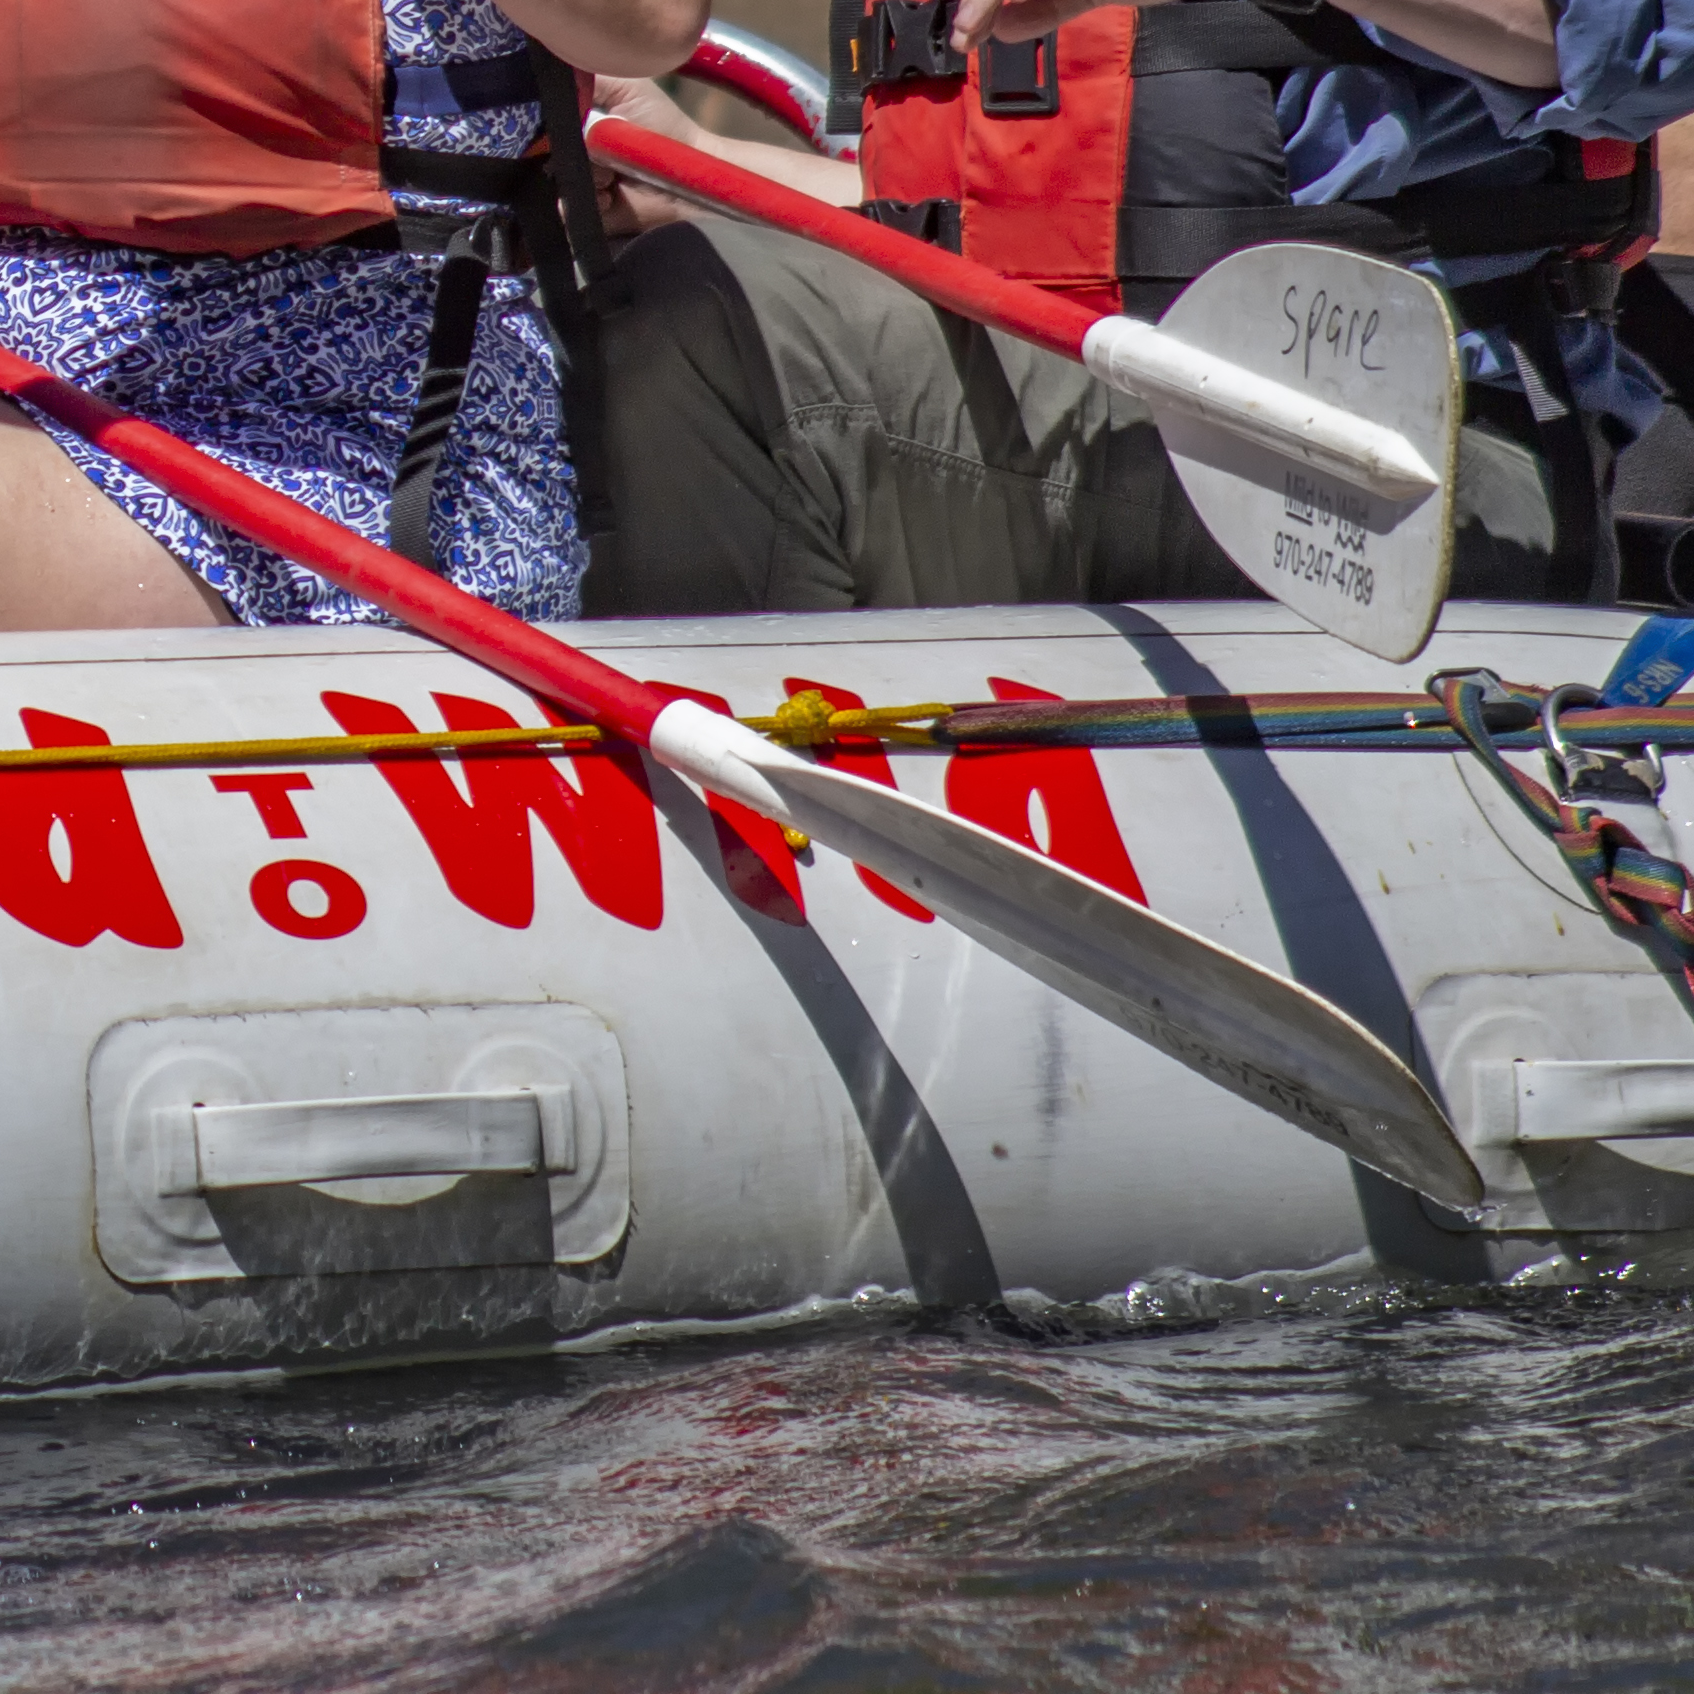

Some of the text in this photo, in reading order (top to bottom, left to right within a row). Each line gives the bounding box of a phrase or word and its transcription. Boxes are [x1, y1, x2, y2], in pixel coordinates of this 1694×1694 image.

[1281, 285, 1386, 379] Spare
[1284, 470, 1314, 519] Mild
[1273, 530, 1375, 606] 970-247-4789
